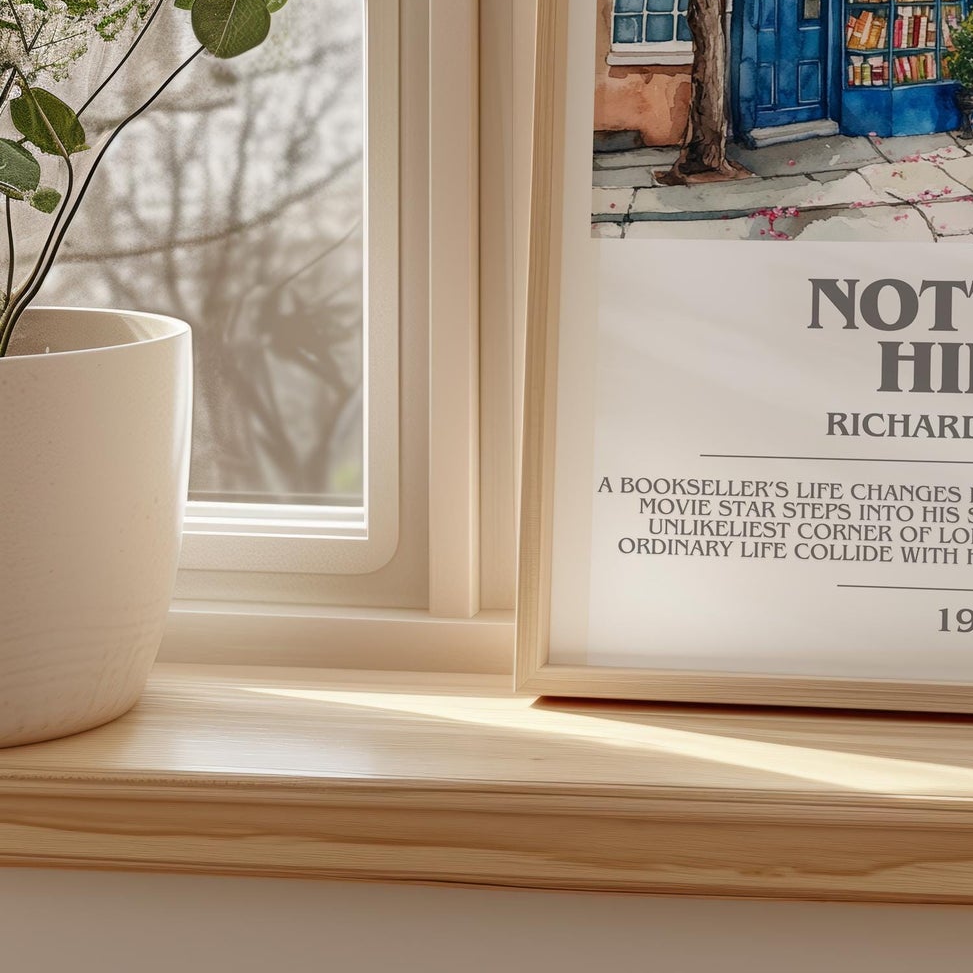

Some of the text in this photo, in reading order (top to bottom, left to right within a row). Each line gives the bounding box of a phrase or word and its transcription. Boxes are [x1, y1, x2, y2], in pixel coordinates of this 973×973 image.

[597, 477, 613, 493] A
[620, 477, 789, 498] BOOKSELLER'S
[797, 482, 844, 499] LIFE
[851, 484, 961, 503] CHANGES
[640, 498, 712, 516] MOVIE
[719, 500, 776, 518] STAR
[783, 502, 851, 520] STEPS
[859, 504, 914, 522] INTO
[922, 506, 960, 524] HIS
[649, 518, 791, 538] UNLIKELIEST
[797, 523, 893, 542] CORNER
[900, 526, 932, 543] OF
[618, 538, 733, 557] ORDINARY
[741, 541, 787, 559] LIFE
[794, 543, 893, 562] COLLIDE
[900, 546, 958, 564] WITH
